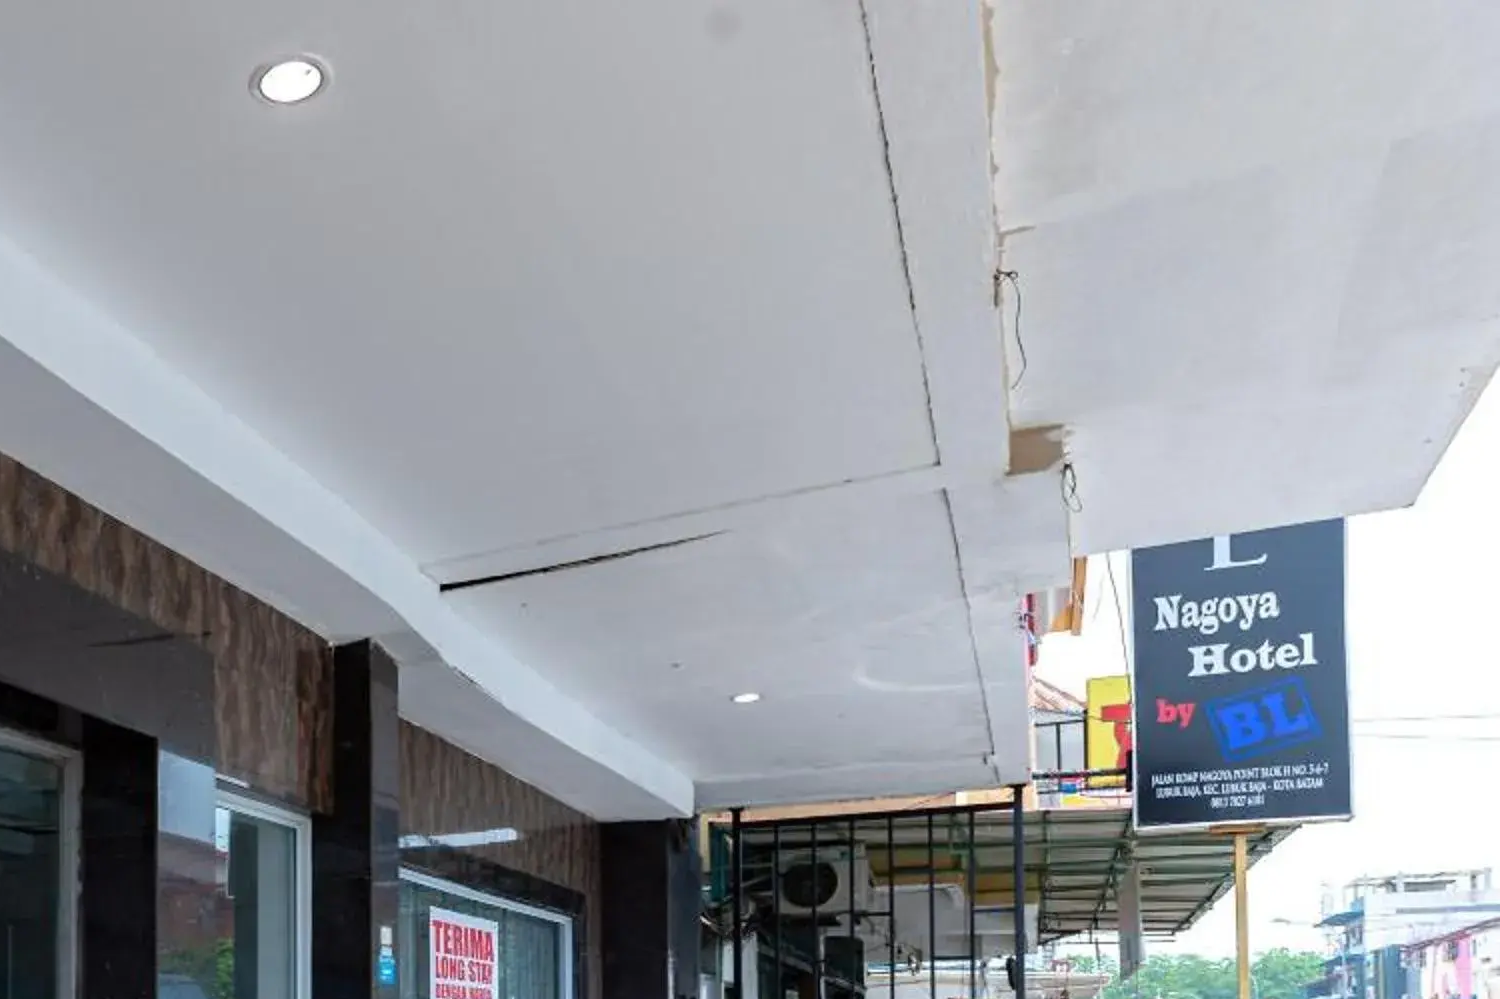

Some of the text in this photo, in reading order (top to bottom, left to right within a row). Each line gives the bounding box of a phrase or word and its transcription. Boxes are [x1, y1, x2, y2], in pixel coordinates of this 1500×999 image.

[1153, 591, 1280, 635] Nagoya
[1187, 632, 1318, 678] Hotel
[1155, 691, 1310, 750] by BL
[431, 919, 494, 963] TERIMA
